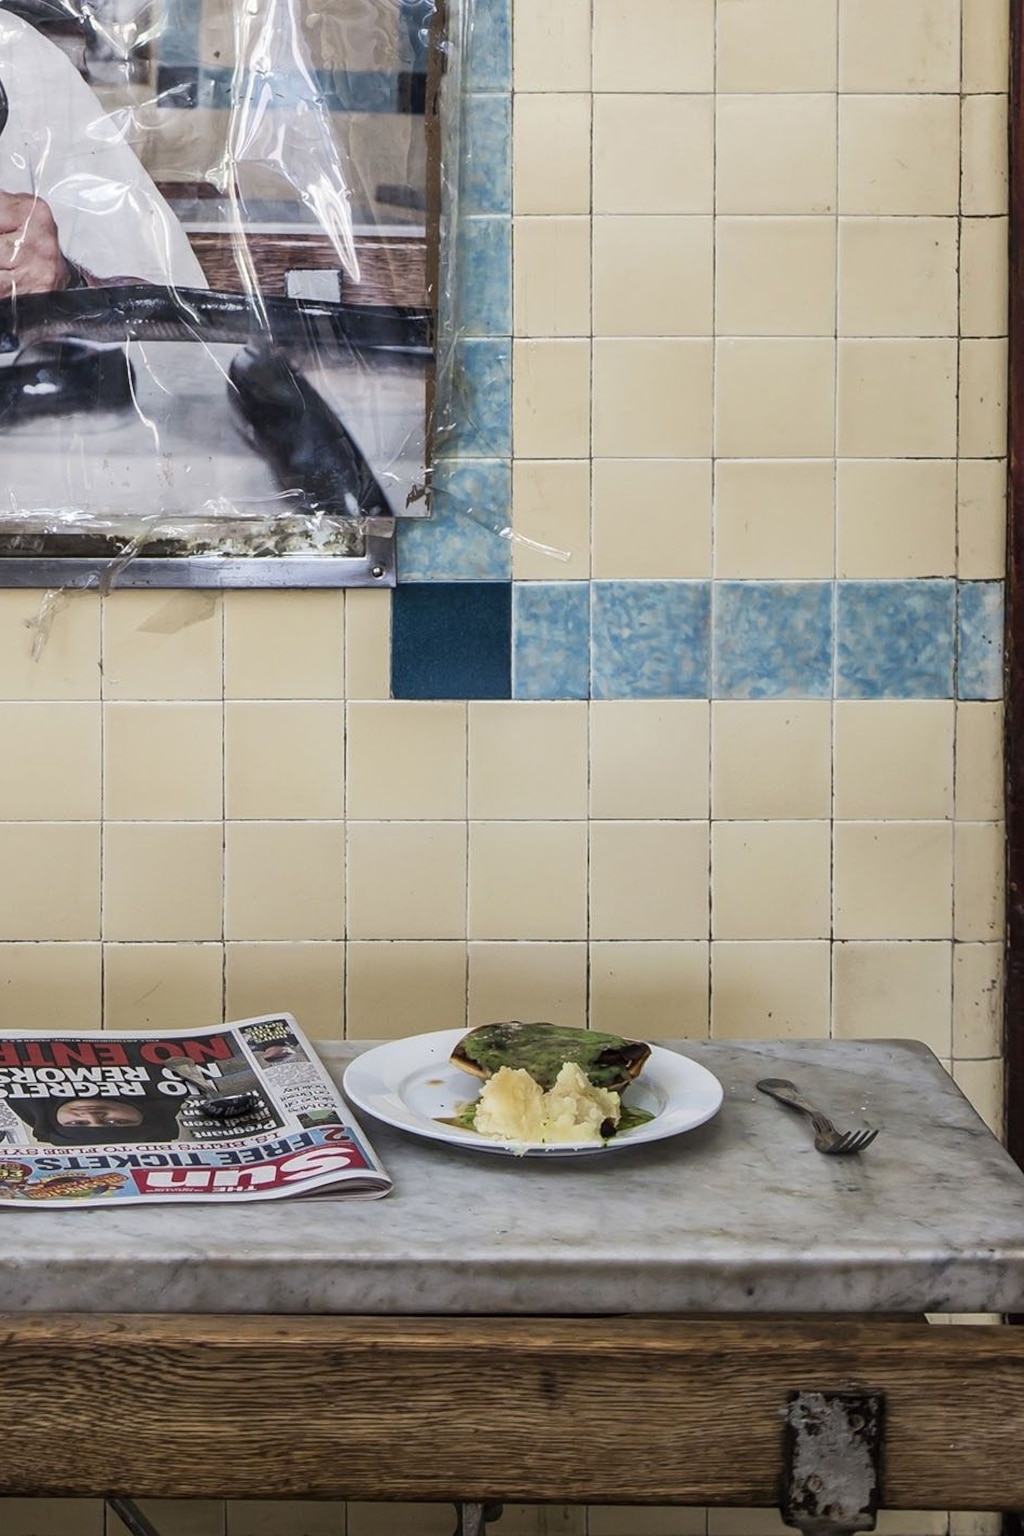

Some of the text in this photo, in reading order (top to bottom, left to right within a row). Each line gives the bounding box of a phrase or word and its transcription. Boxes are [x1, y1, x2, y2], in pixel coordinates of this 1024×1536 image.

[140, 1036, 233, 1065] NO
[224, 1107, 271, 1128] jihadi
[192, 1120, 277, 1139] Pregnant
[32, 1127, 350, 1172] 2 FREE TICKETS
[43, 1147, 97, 1155] FLEE
[179, 1140, 246, 1151] BRIT'S
[147, 1147, 351, 1189] Sun
